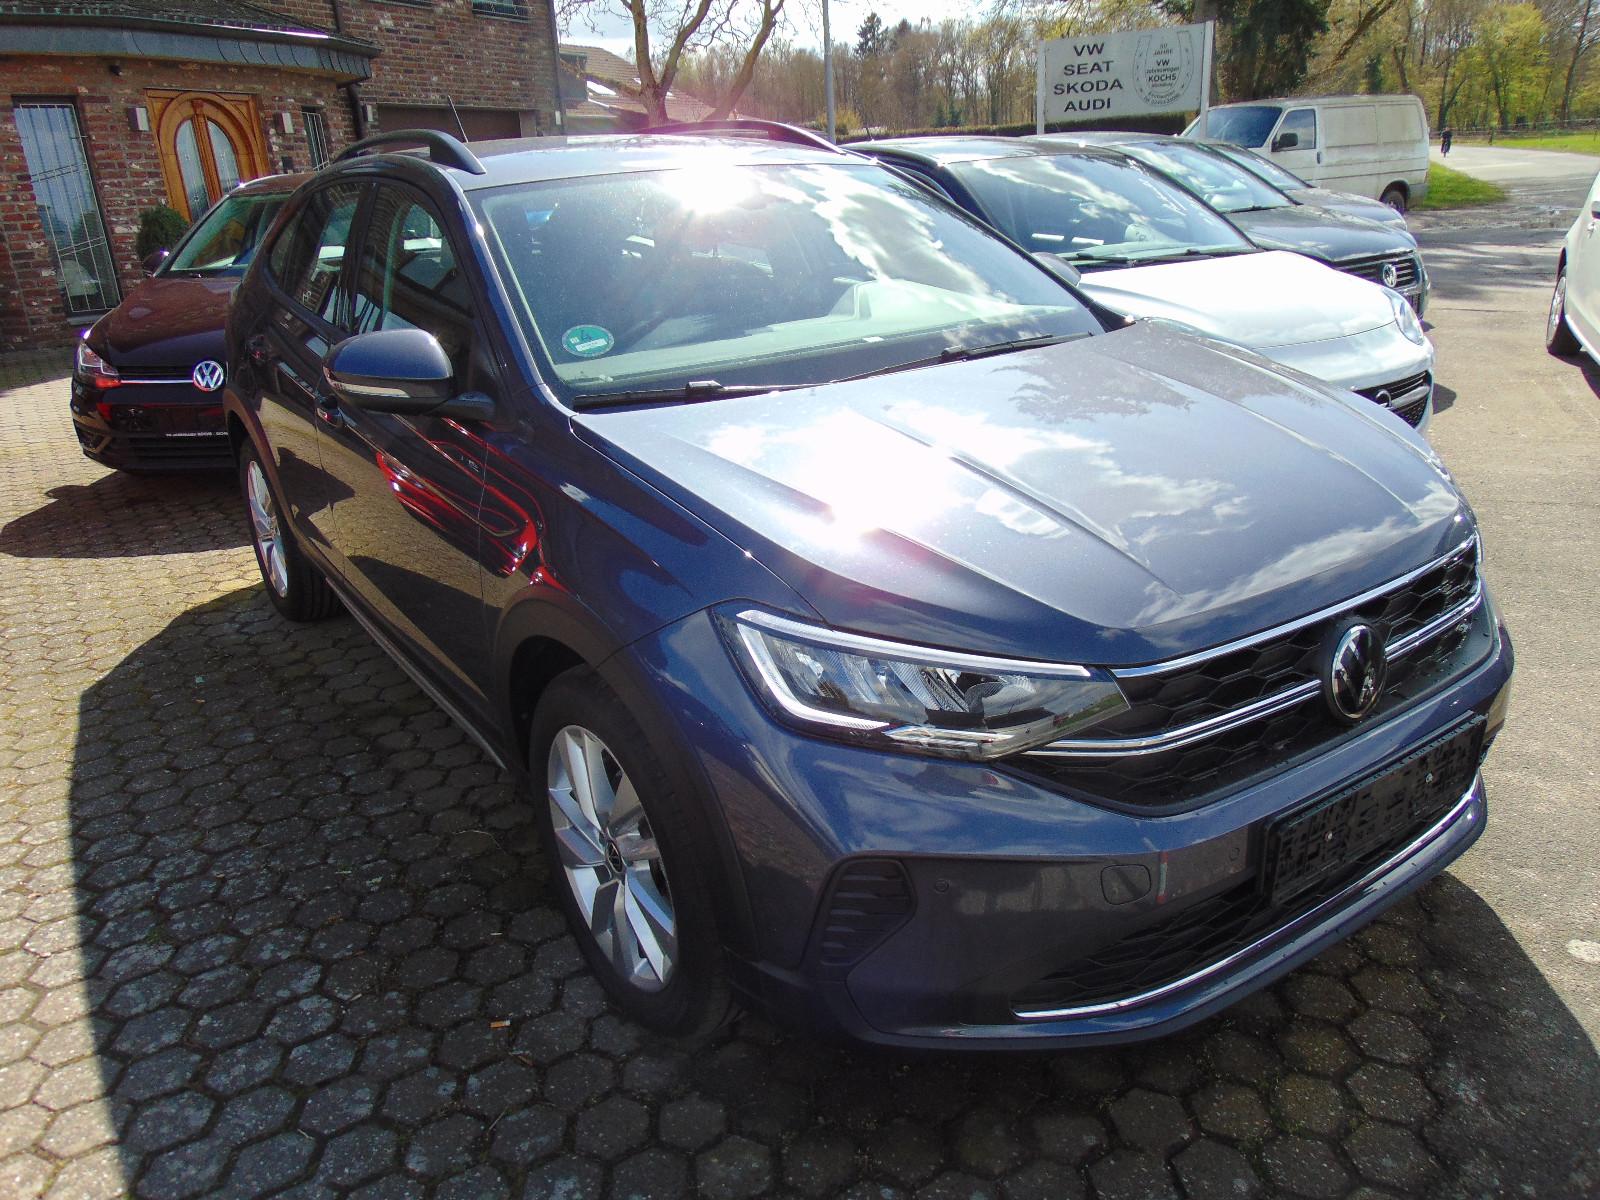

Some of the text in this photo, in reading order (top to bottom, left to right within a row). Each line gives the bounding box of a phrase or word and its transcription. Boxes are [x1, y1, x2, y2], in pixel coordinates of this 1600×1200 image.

[1073, 43, 1105, 57] VW
[1063, 60, 1114, 76] SEAT
[1148, 73, 1177, 83] KOCHS
[1053, 78, 1123, 96] SKODA
[1064, 97, 1111, 113] AUDI
[193, 360, 224, 391] VW
